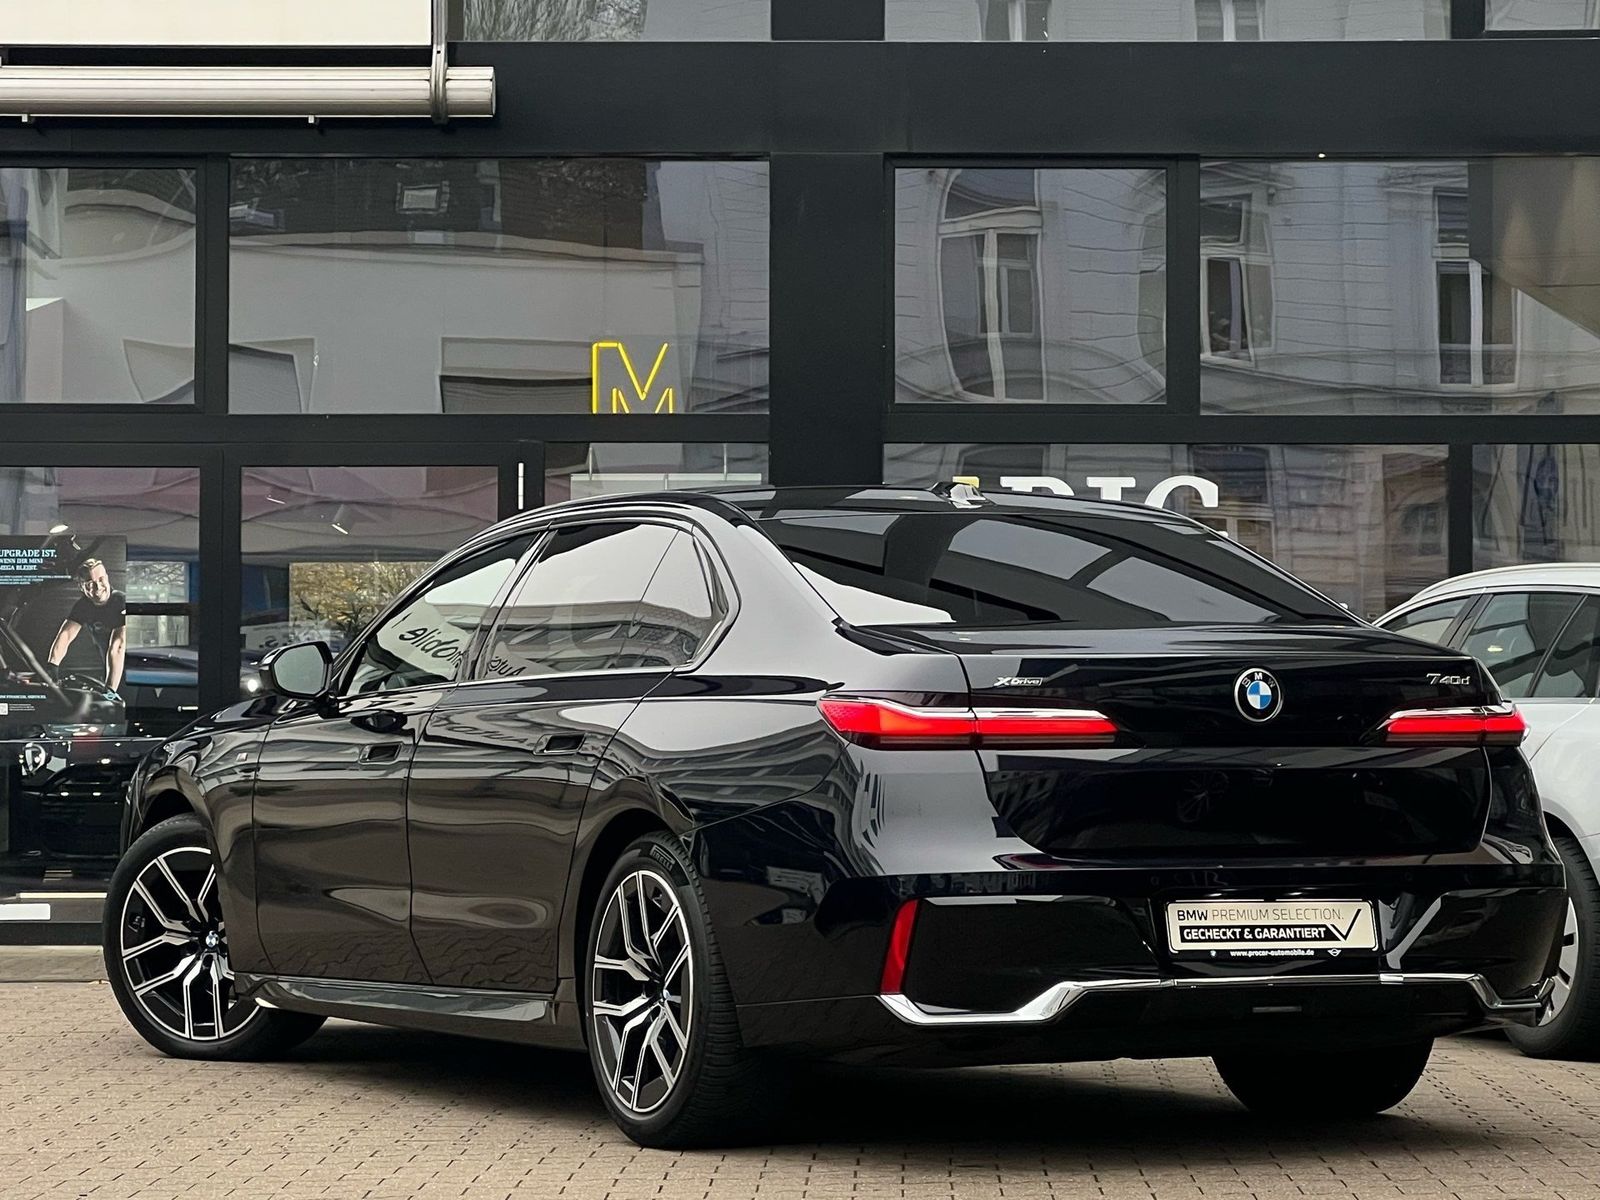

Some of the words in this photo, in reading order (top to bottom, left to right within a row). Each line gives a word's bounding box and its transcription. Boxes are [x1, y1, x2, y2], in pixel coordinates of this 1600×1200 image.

[41, 549, 57, 558] IST.
[1426, 673, 1471, 685] 740d
[1177, 909, 1208, 921] BMW
[1212, 909, 1269, 921] PREMIUM
[1272, 908, 1344, 921] SELECTION.
[1183, 928, 1241, 940] GECHECKT
[1244, 928, 1253, 940] &
[1254, 927, 1326, 940] GARANTIERT
[1230, 949, 1315, 958] www.procar-automobile.de
